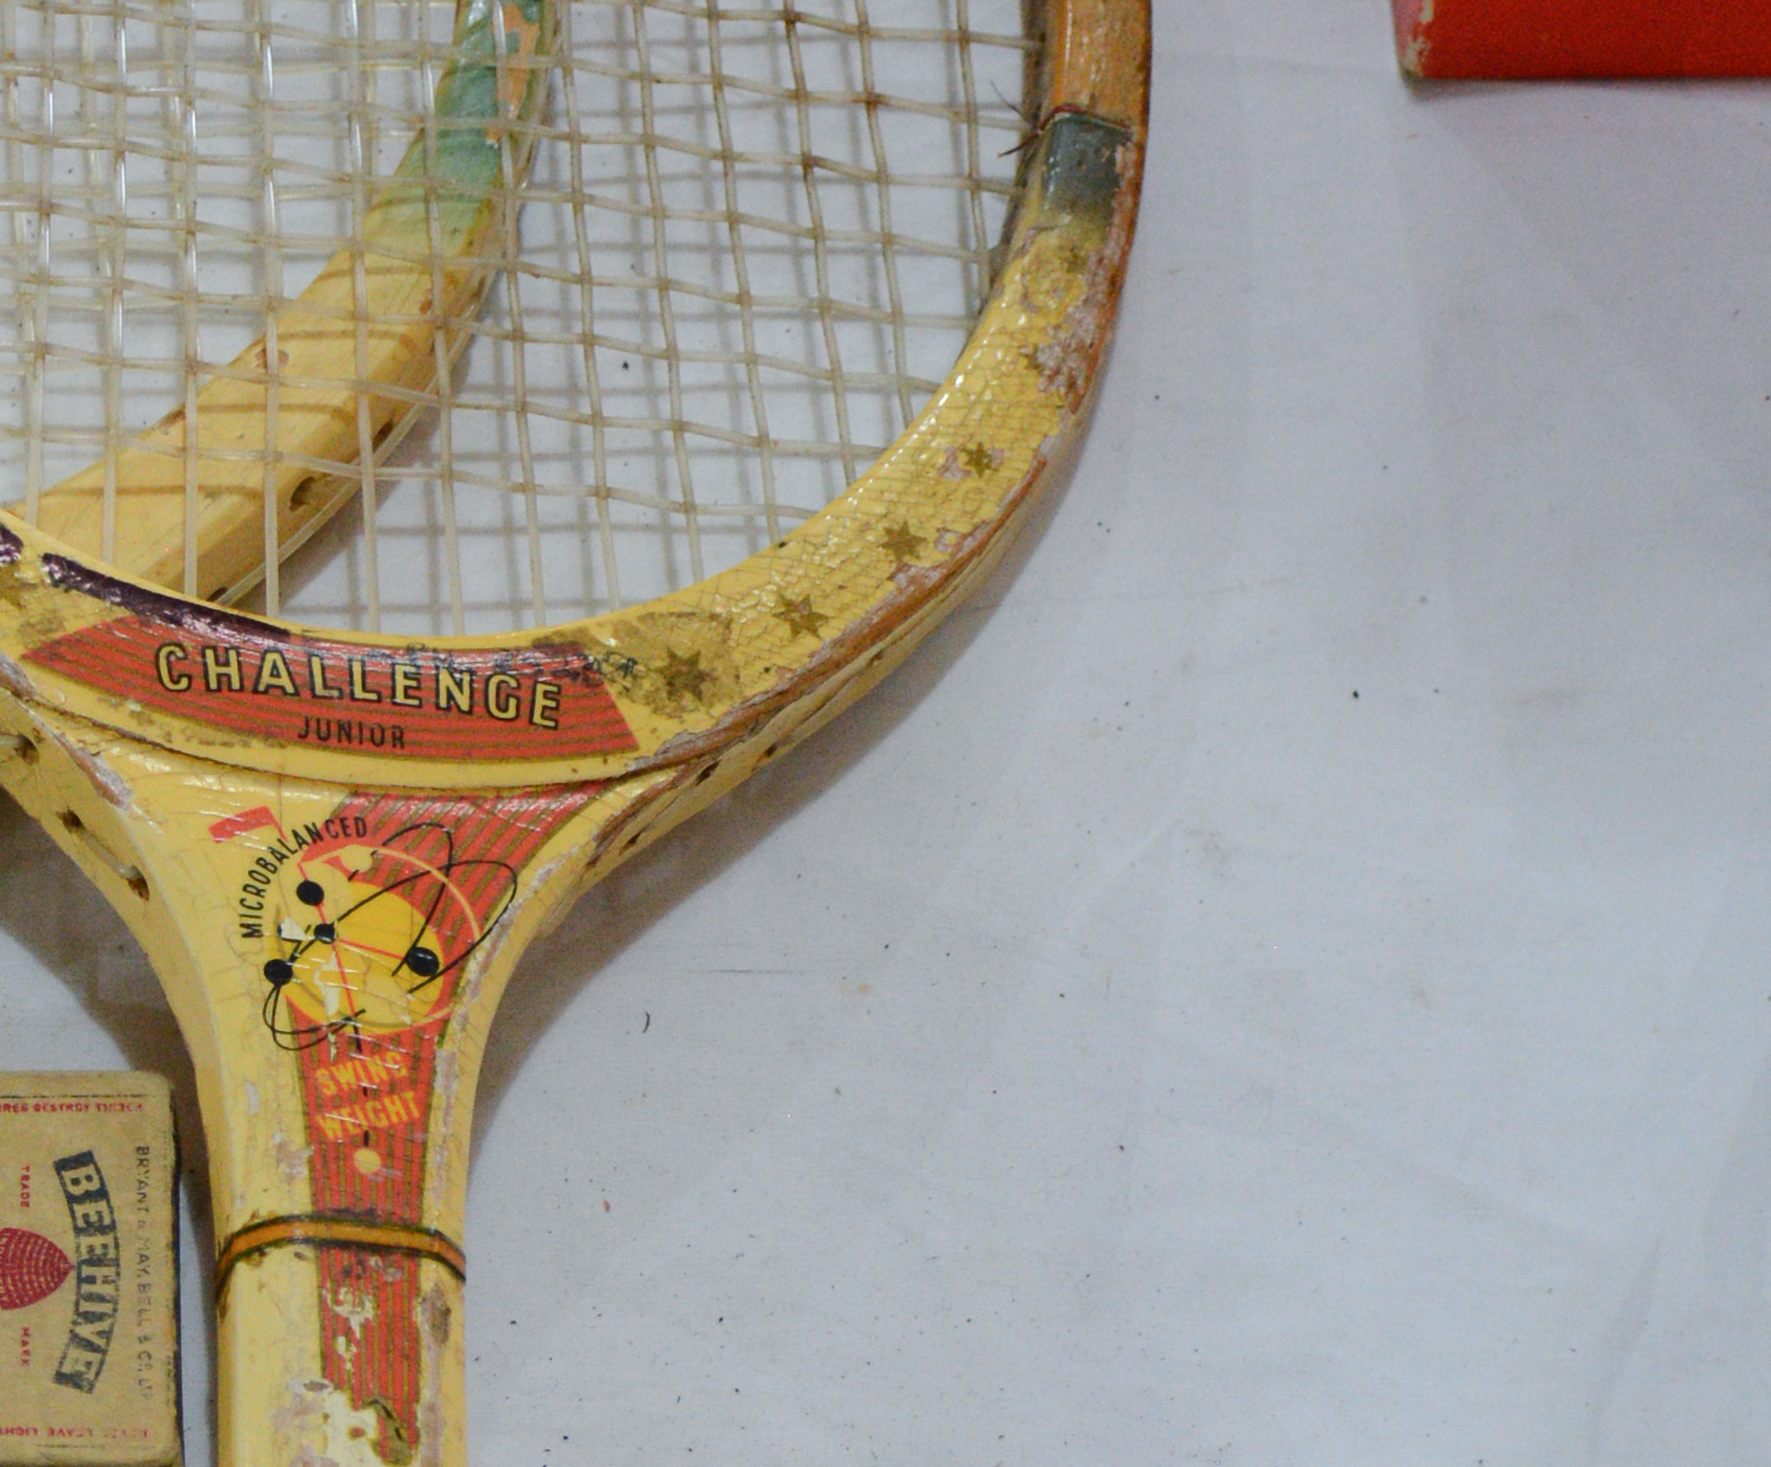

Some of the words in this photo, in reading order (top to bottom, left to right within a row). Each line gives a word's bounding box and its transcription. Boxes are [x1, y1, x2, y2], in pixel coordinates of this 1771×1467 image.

[156, 641, 563, 731] CHALLENGE
[297, 716, 406, 750] JUNIOR
[238, 815, 369, 940] MICROBALANCED
[315, 1051, 409, 1098] SWING
[315, 1089, 422, 1141] WEIGHT
[20, 1165, 30, 1208] TRADE
[135, 1146, 150, 1212] BRYANT
[58, 1161, 118, 1384] BEEHIVE
[137, 1283, 151, 1328] BELL
[20, 1326, 30, 1366] MARK
